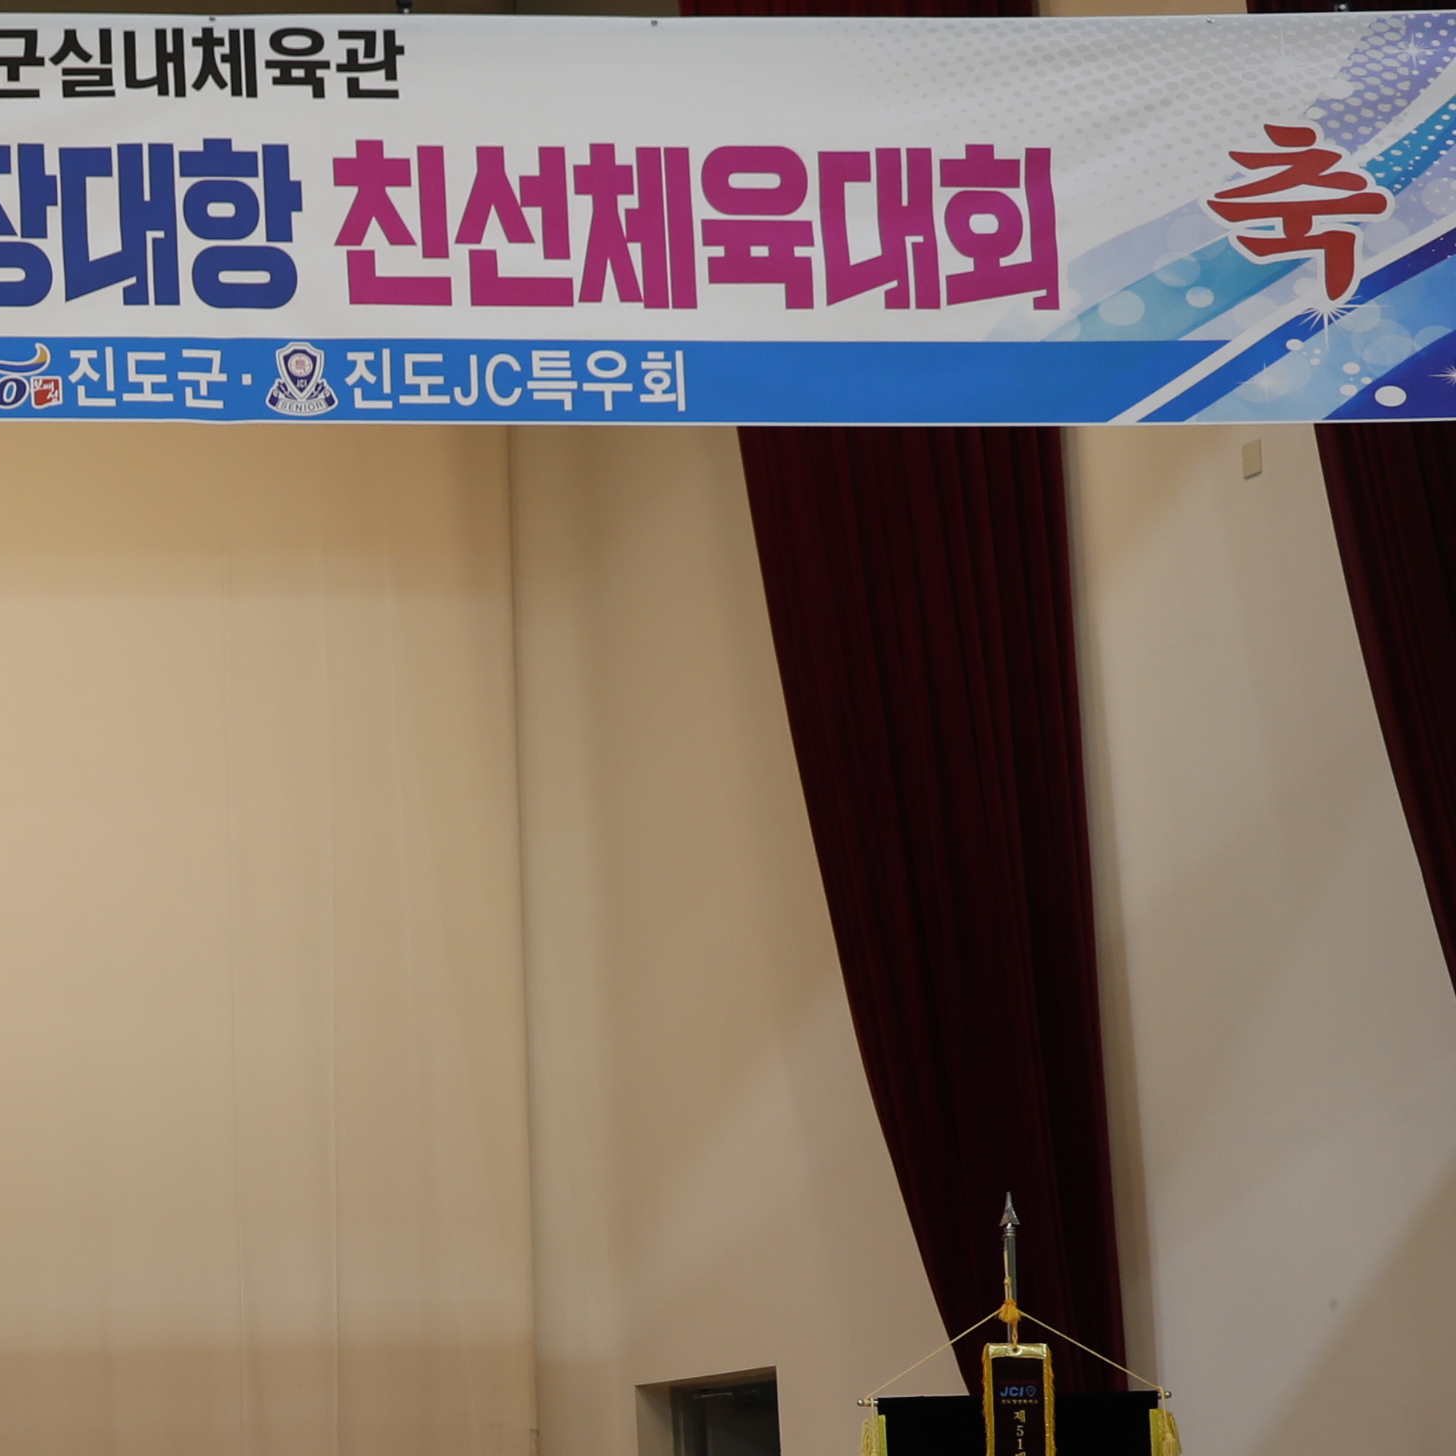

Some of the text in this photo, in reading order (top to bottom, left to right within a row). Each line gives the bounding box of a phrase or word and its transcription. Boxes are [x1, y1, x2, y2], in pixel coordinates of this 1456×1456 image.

[332, 139, 1059, 310] 친선체육대회
[1207, 123, 1388, 301] 축
[280, 401, 324, 413] SENIOR
[344, 347, 687, 411] 진도JC특우회
[1000, 1386, 1024, 1397] JCI
